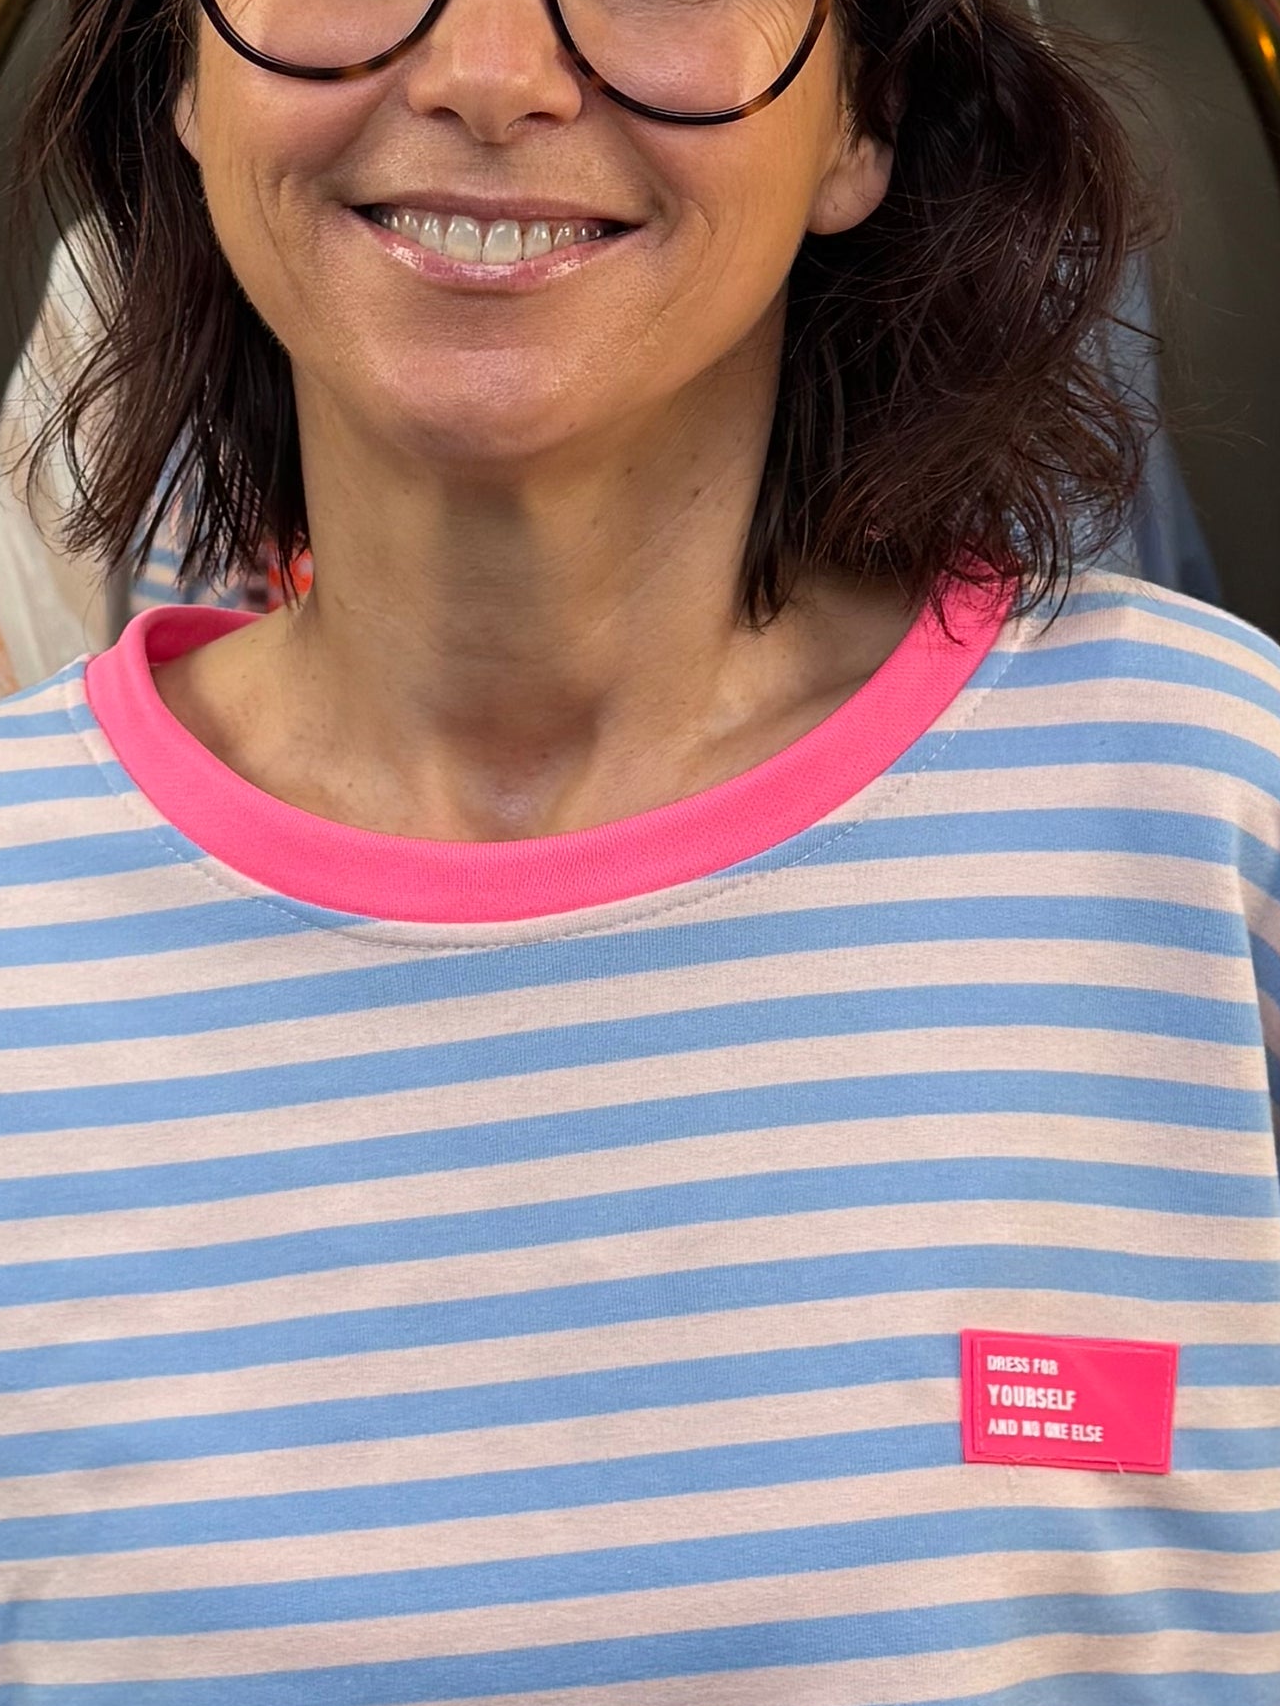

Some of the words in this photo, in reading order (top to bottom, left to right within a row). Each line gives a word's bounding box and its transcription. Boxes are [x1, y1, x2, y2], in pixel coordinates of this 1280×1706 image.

[986, 1354, 1030, 1374] DRESS
[1032, 1358, 1059, 1376] FOR
[986, 1383, 1077, 1411] YOURSELF
[987, 1418, 1019, 1436] AND
[1022, 1420, 1041, 1438] NO
[1044, 1421, 1070, 1440] ONE
[1071, 1424, 1105, 1443] ELSE
